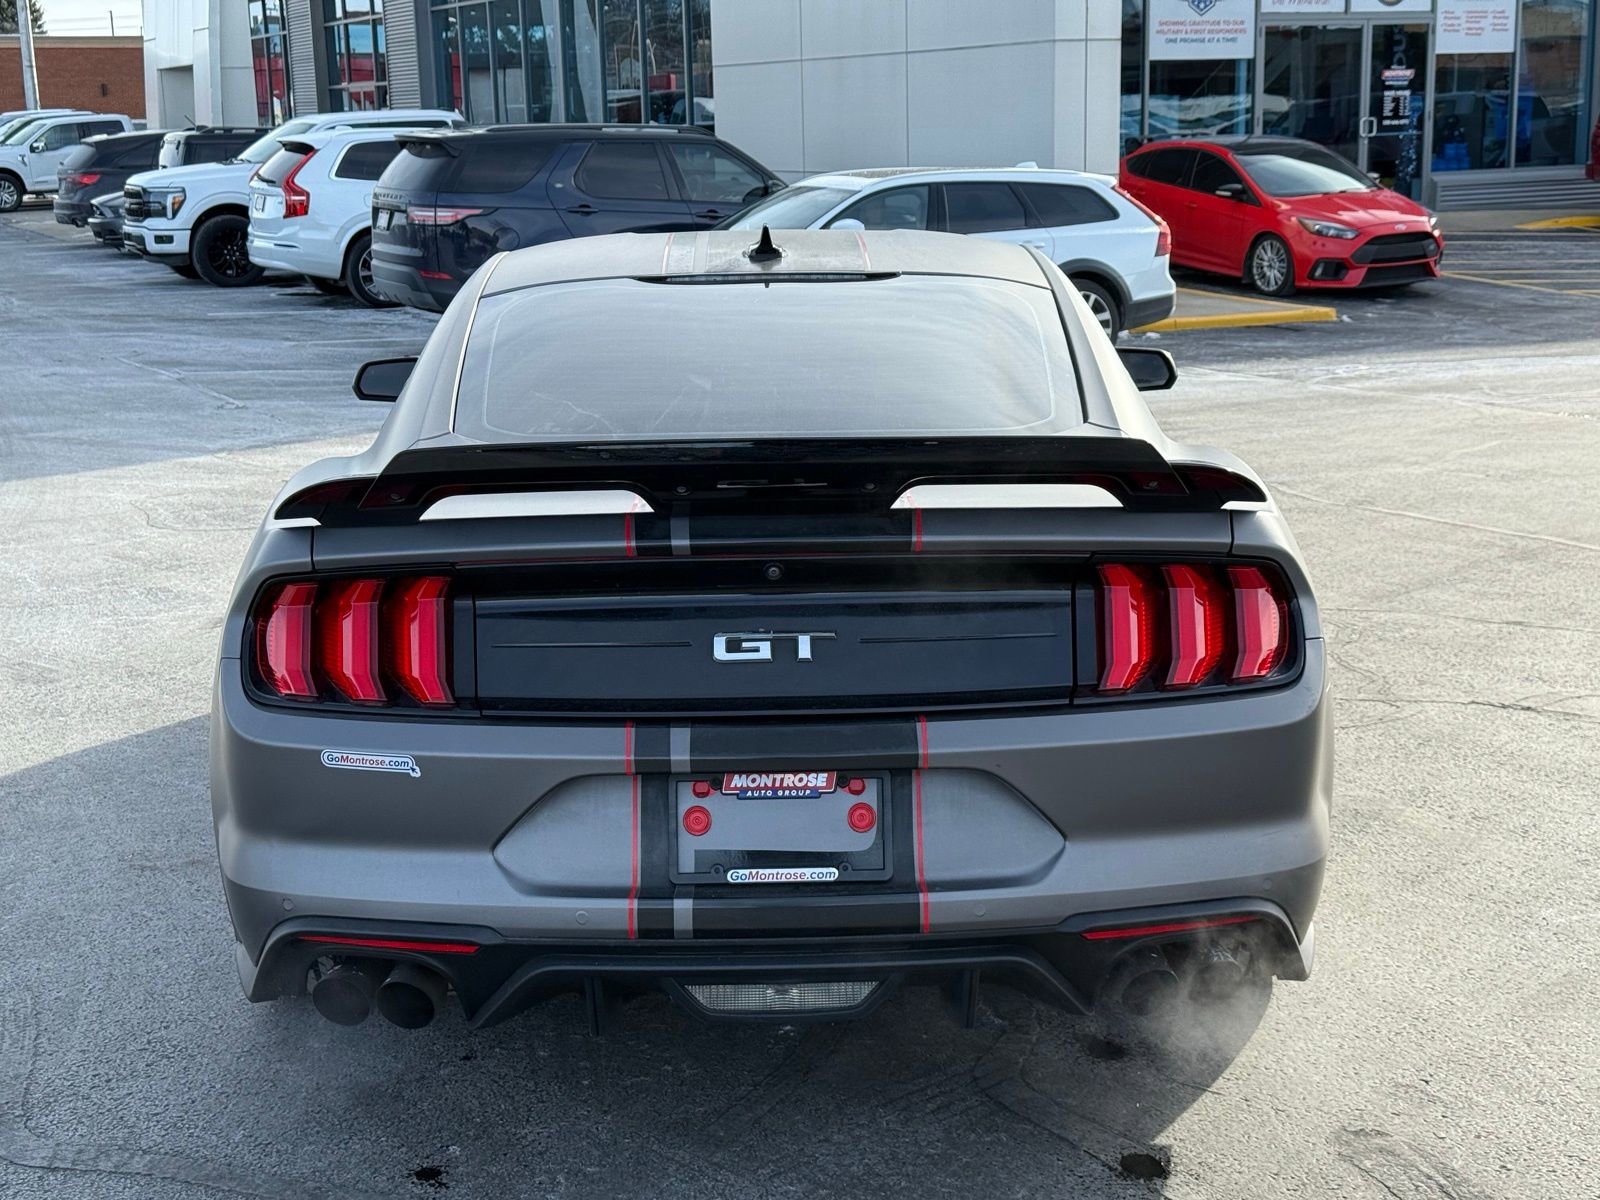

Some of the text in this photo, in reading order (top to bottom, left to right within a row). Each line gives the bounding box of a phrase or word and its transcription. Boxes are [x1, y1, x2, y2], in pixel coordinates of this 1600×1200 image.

[712, 631, 837, 663] GT
[326, 753, 410, 768] GoMontrose.com
[729, 773, 829, 788] MONTROSE
[746, 789, 773, 797] AUTO
[729, 869, 836, 882] GoMontrose.com
